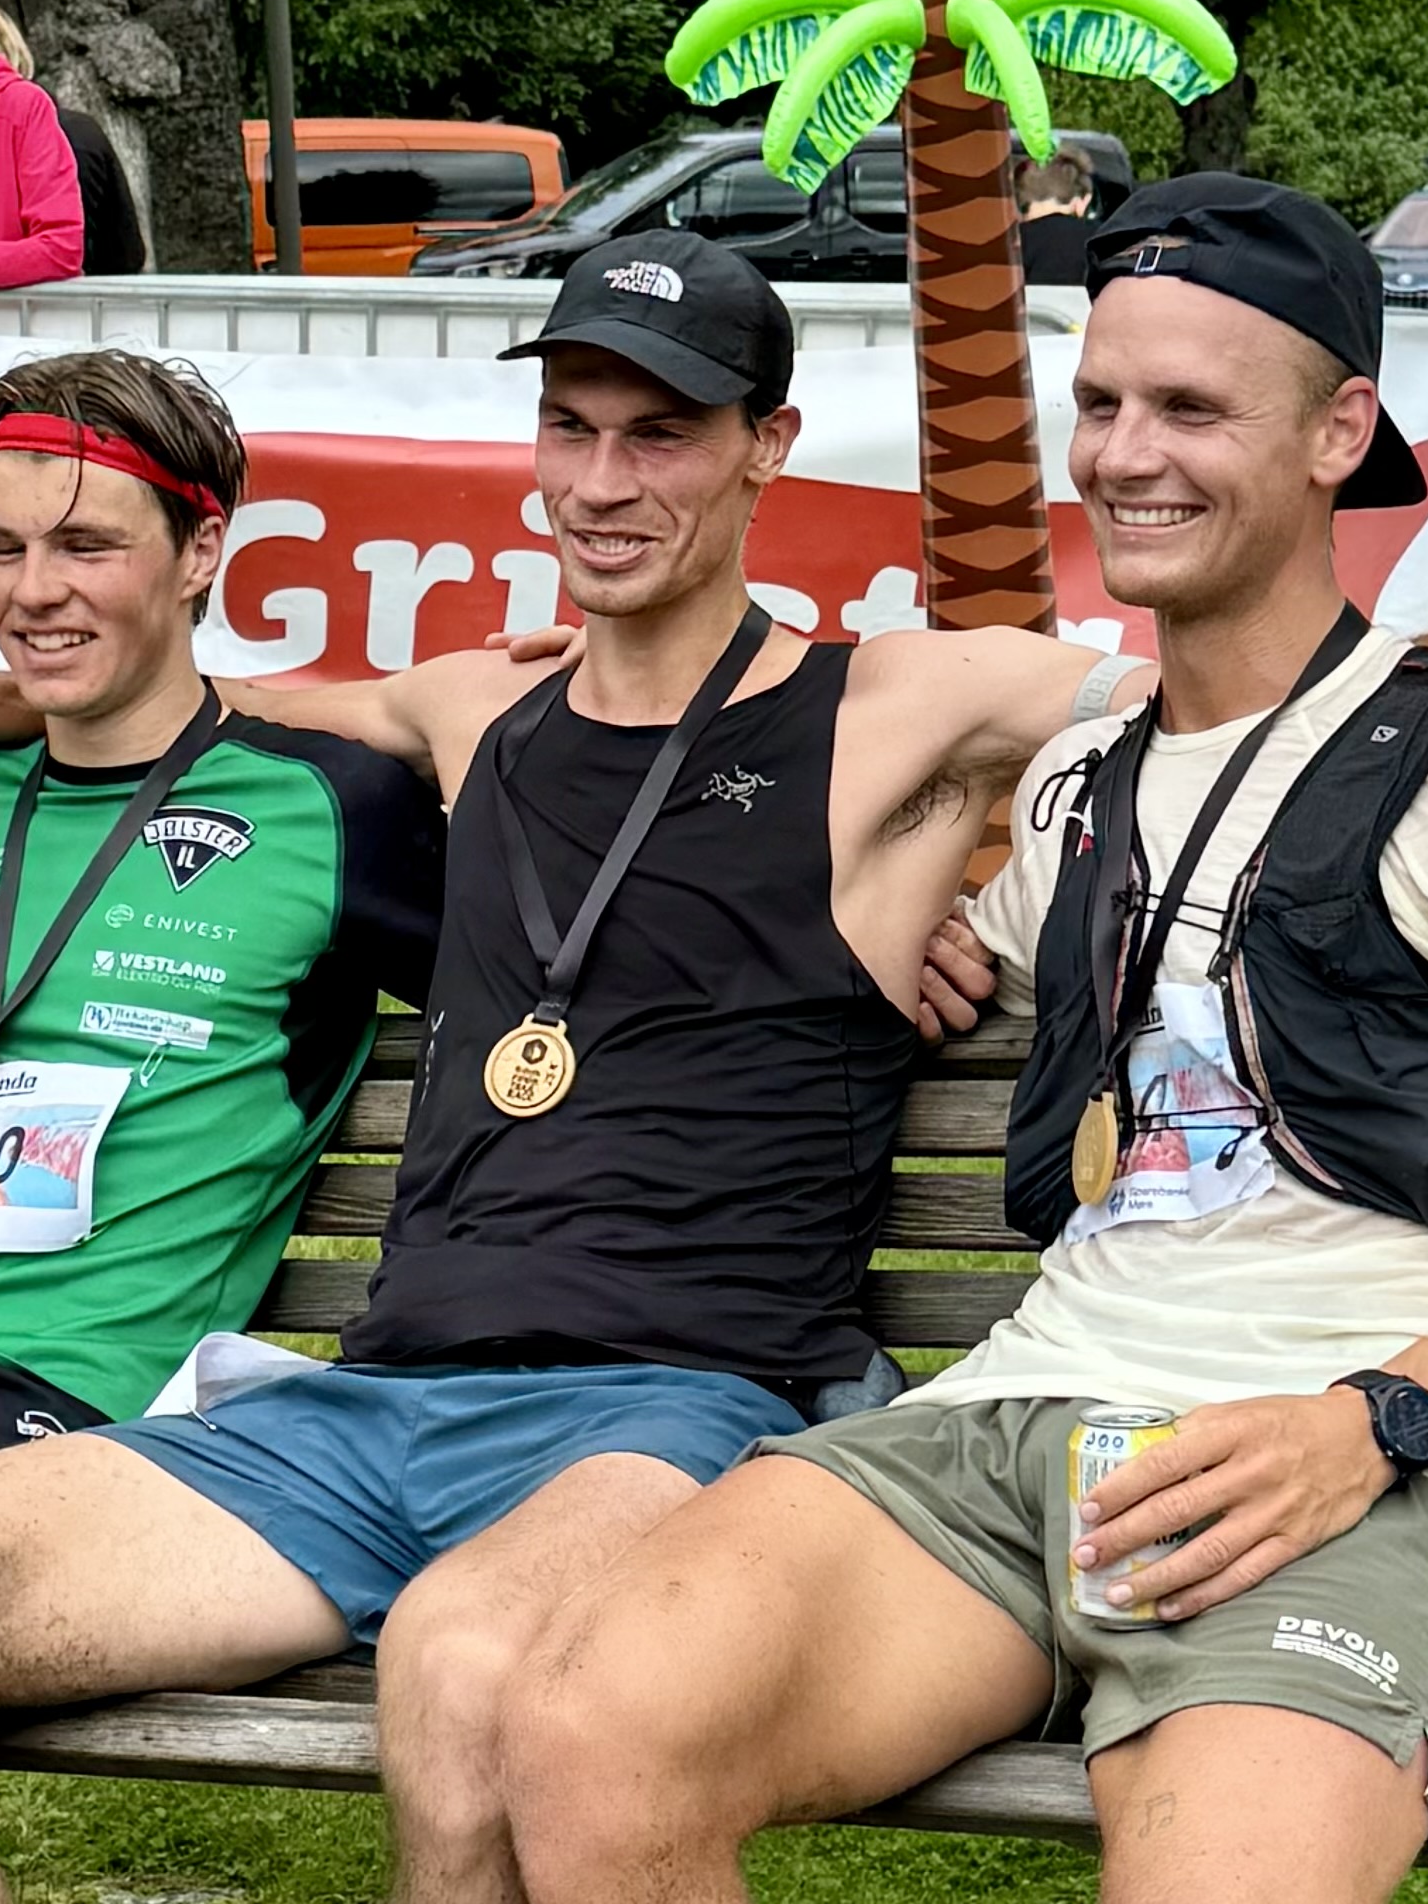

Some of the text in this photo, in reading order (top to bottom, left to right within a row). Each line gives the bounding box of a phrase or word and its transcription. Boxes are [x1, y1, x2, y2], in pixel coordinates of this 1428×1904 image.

[176, 845, 196, 869] IL
[143, 912, 238, 942] ENIVEST
[119, 951, 227, 985] VESTLAND
[1276, 1615, 1400, 1675] DEVOLD
